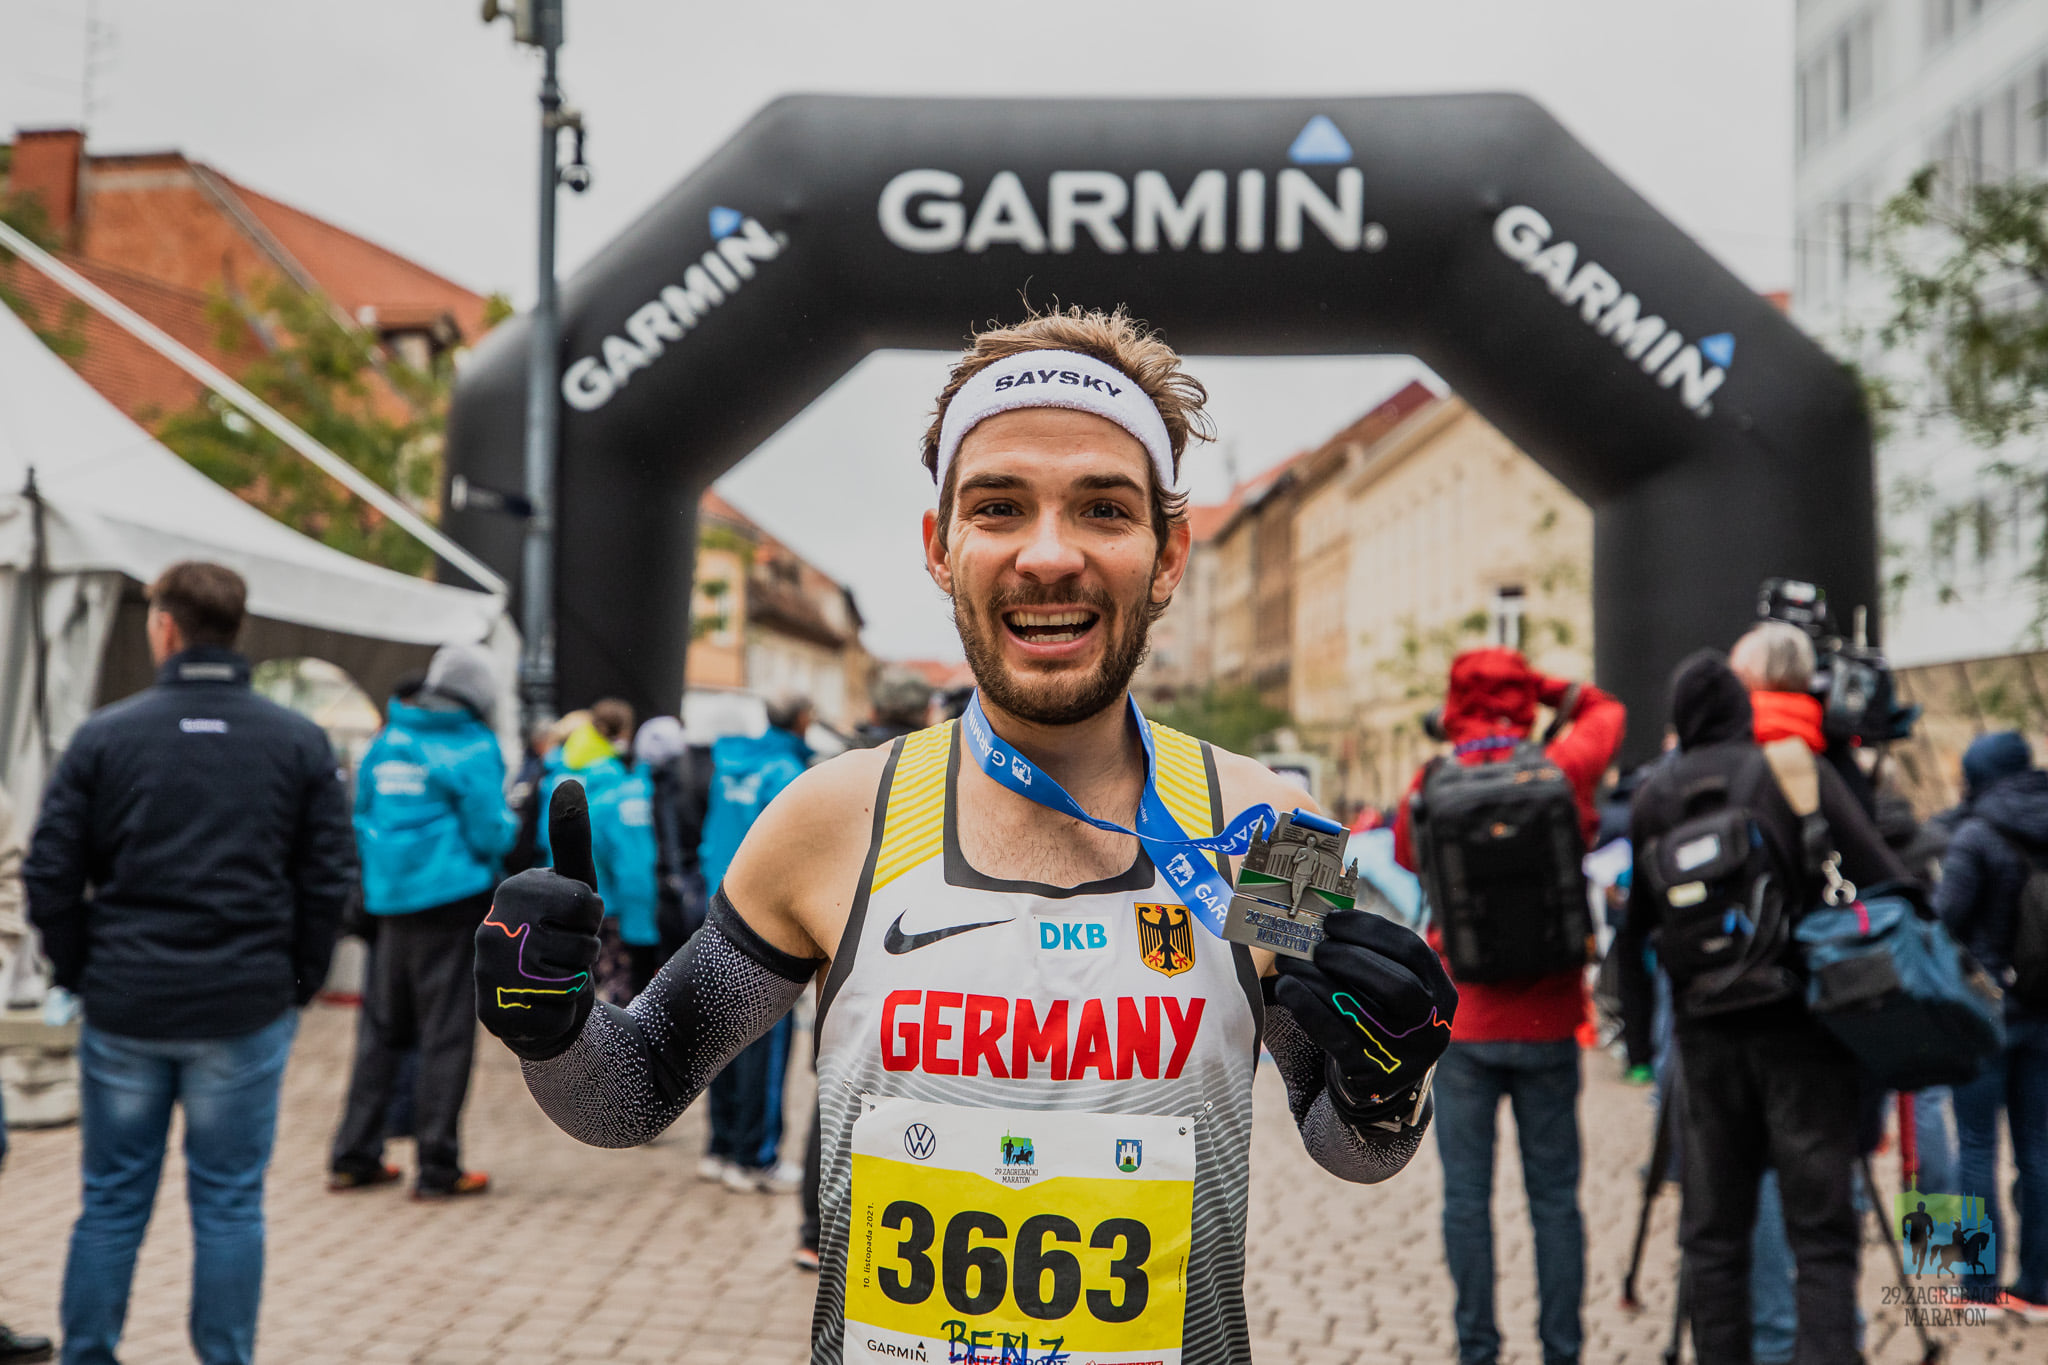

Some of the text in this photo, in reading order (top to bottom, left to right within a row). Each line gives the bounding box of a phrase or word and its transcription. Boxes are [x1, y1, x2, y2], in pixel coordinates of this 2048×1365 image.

[878, 168, 1366, 253] GARMIN
[562, 217, 784, 411] GARMIN
[1493, 205, 1726, 412] GARMIN
[995, 370, 1122, 397] SAYSKY
[969, 706, 1006, 767] GARMIN
[1194, 883, 1228, 924] GAR
[1245, 908, 1325, 942] 29.ZAGREBAČK
[1040, 921, 1108, 950] DKB
[1256, 927, 1311, 953] MARATON
[880, 990, 1206, 1081] GERMANY
[863, 1202, 875, 1289] 10. listopada 2021.
[877, 1200, 1152, 1323] 3663
[867, 1339, 928, 1362] GARMIN
[940, 1319, 1071, 1365] BENZ
